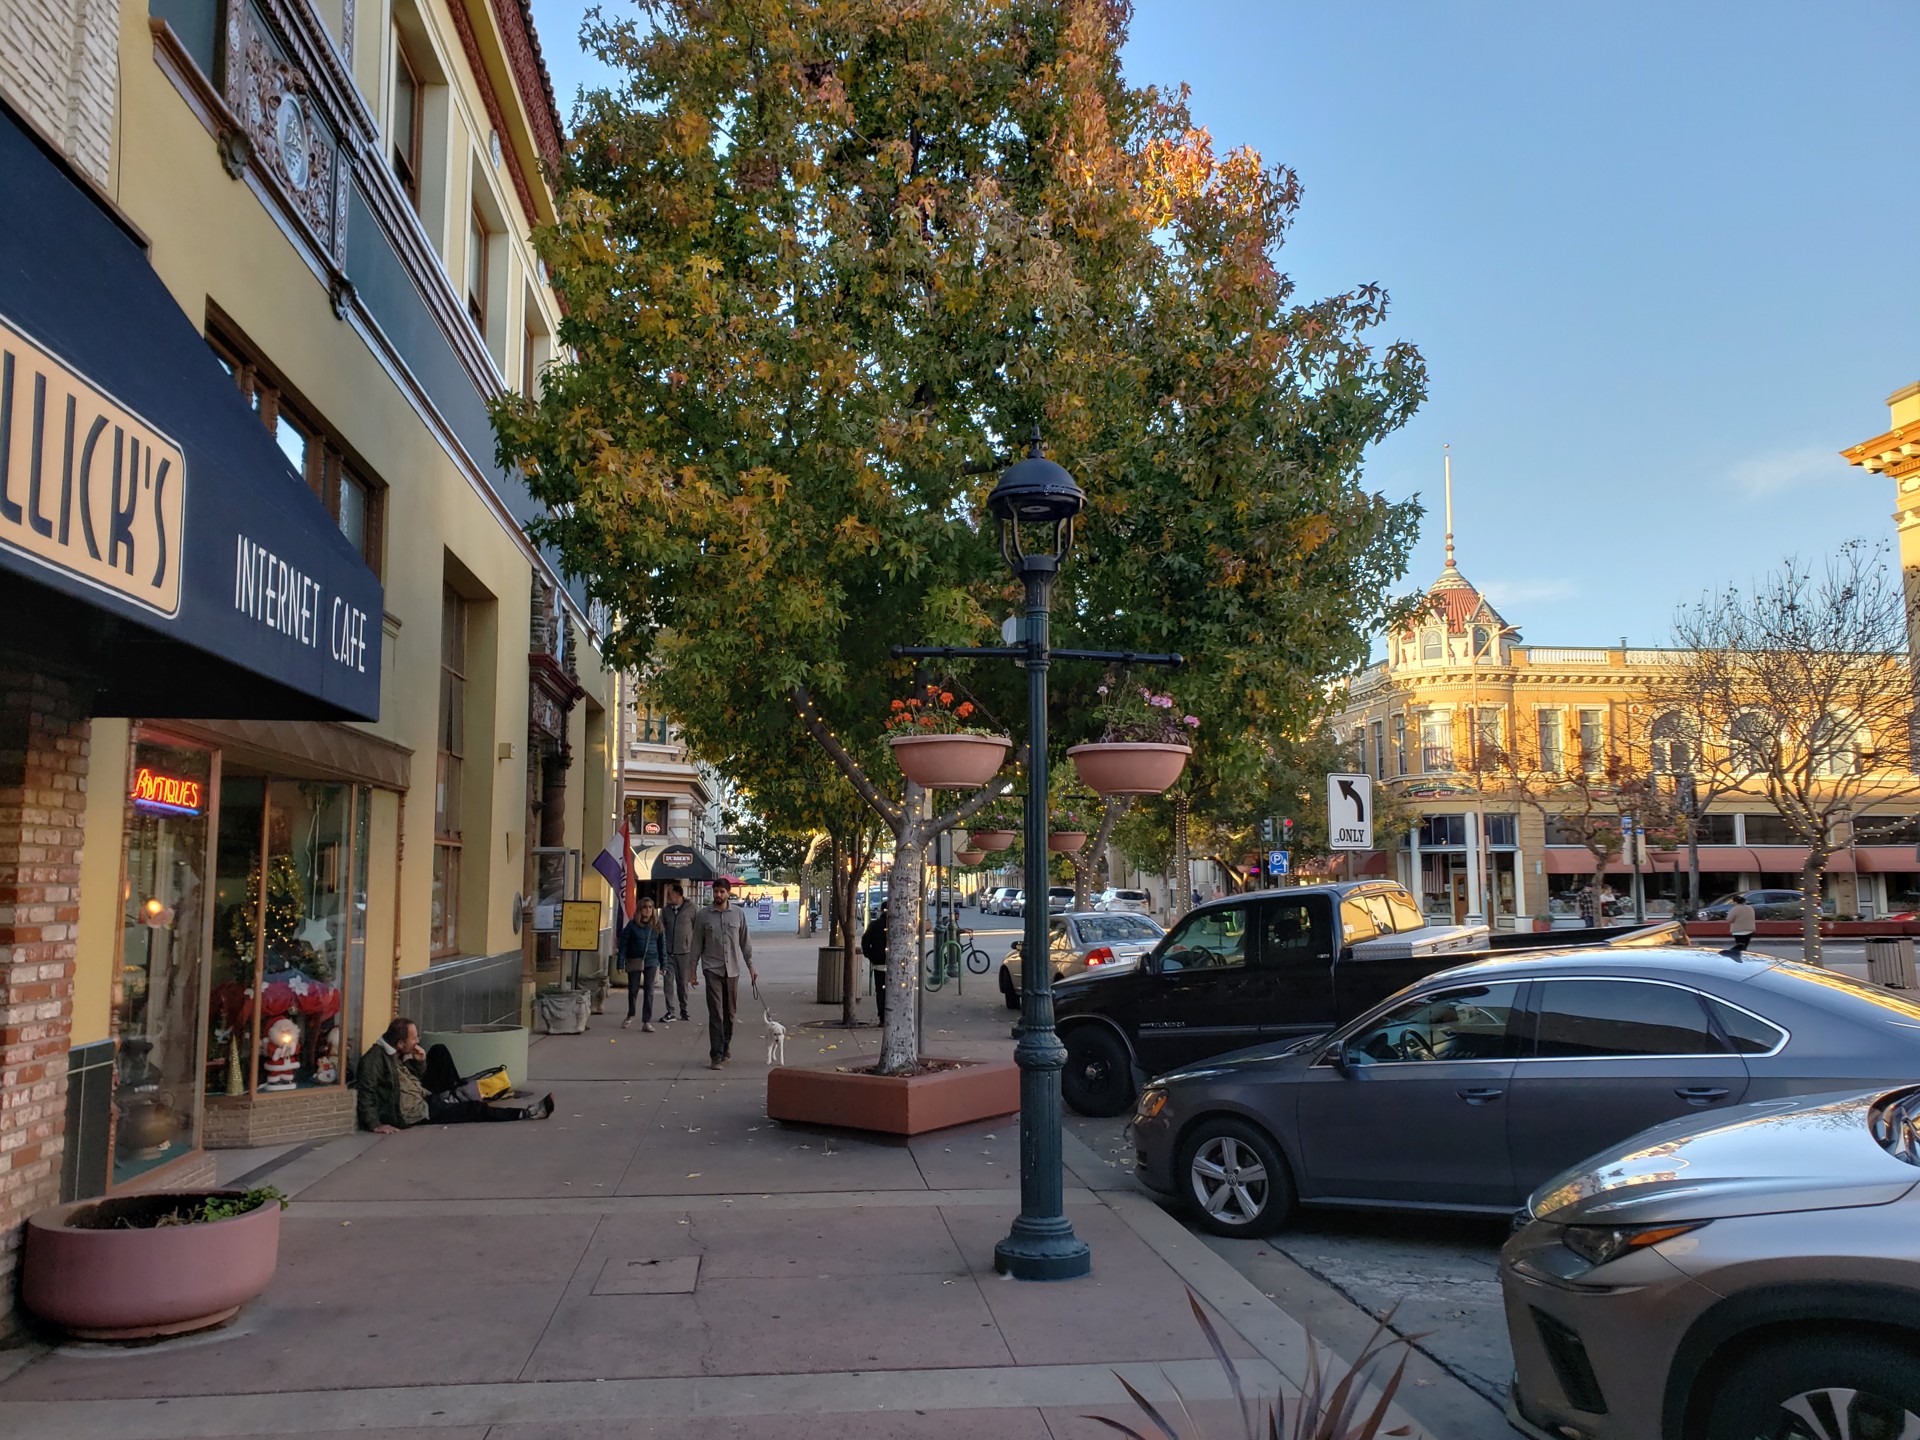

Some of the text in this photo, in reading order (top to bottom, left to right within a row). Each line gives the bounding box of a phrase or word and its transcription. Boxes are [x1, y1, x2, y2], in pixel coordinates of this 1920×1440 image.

[235, 533, 367, 673] INTERNET CAFE
[131, 768, 199, 808] ANTIQUES
[1339, 828, 1365, 843] ONLY
